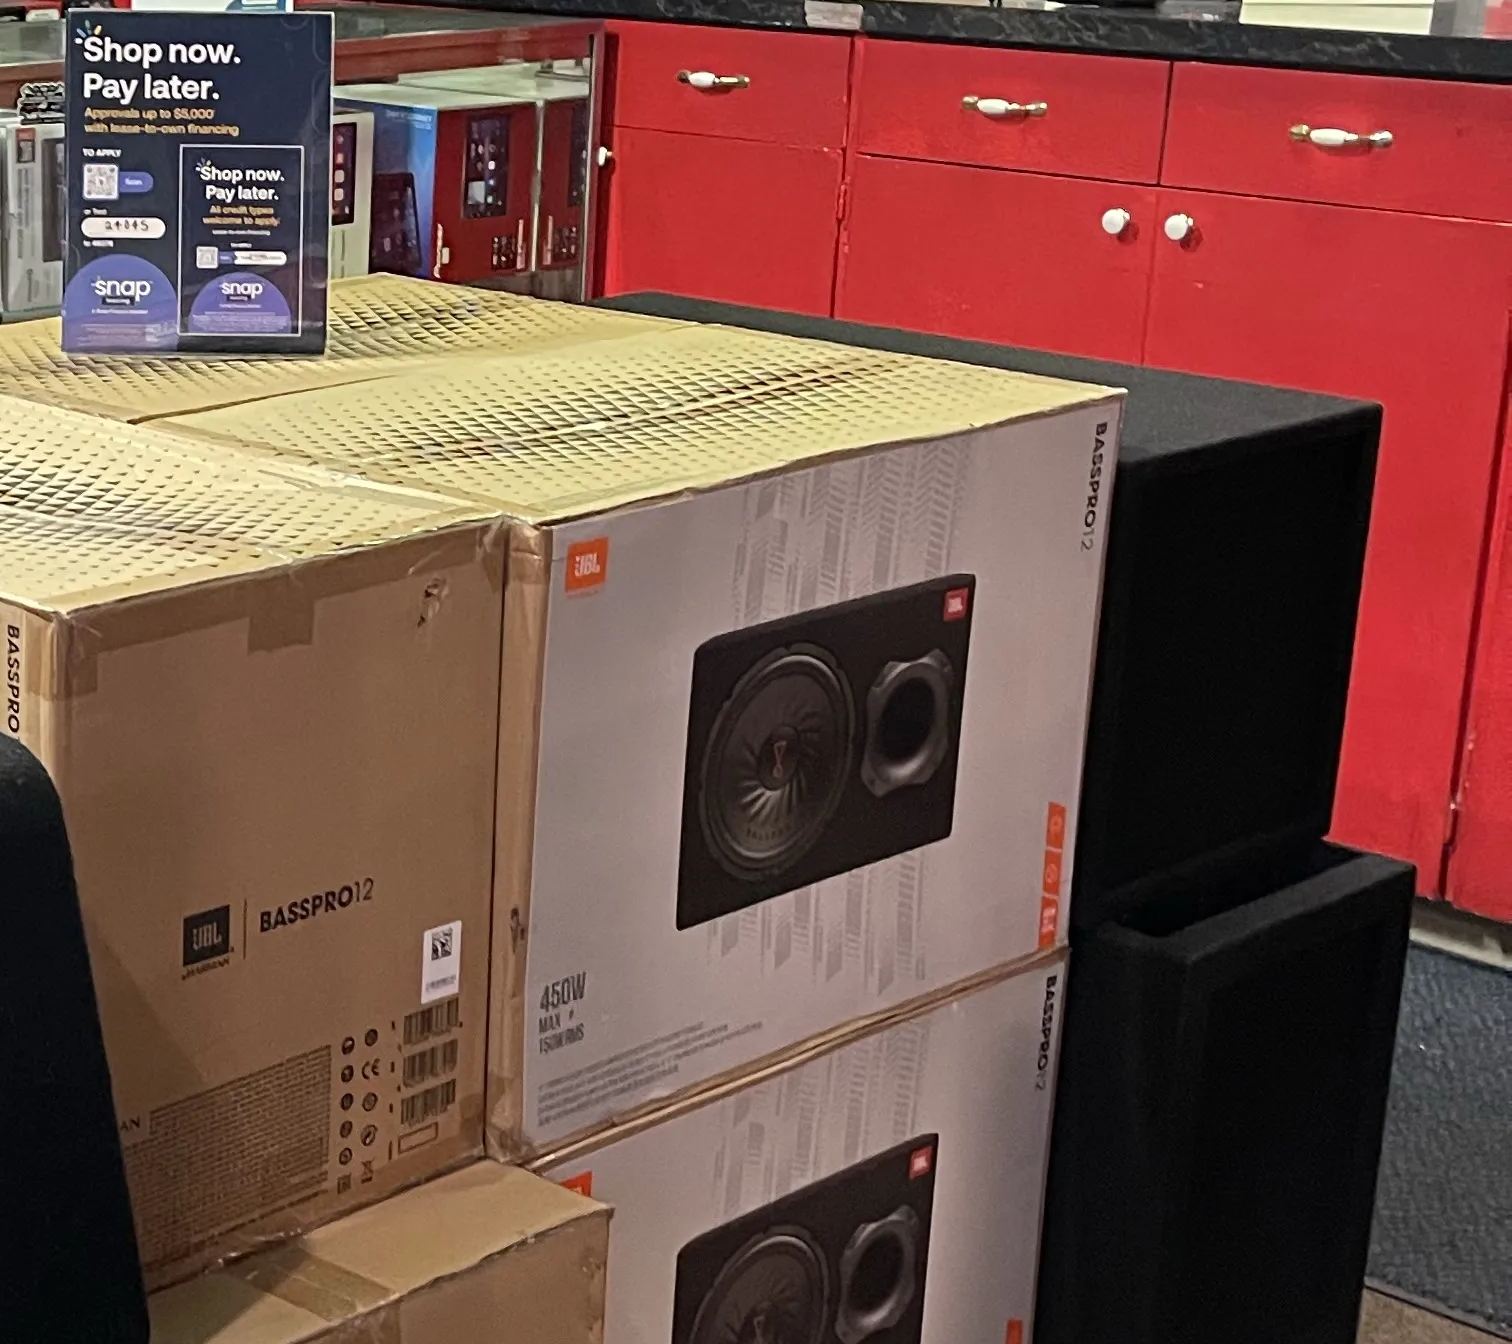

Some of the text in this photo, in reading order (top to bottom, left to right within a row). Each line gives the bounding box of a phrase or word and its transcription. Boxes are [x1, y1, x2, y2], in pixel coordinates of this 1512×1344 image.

[83, 35, 241, 69] Shop now.
[83, 72, 139, 105] Pay
[144, 73, 220, 100] later.
[159, 108, 172, 119] to
[200, 165, 285, 184] Shop now.
[205, 185, 279, 203] Pay later.
[95, 279, 152, 301] snap
[221, 281, 264, 299] snap
[1080, 421, 1108, 553] BASSPRO12
[5, 624, 22, 734] BASSPRO
[192, 877, 375, 950] JBL BASSPRO12
[540, 971, 587, 1012] 450W
[1034, 975, 1058, 1092] BASSPRO12
